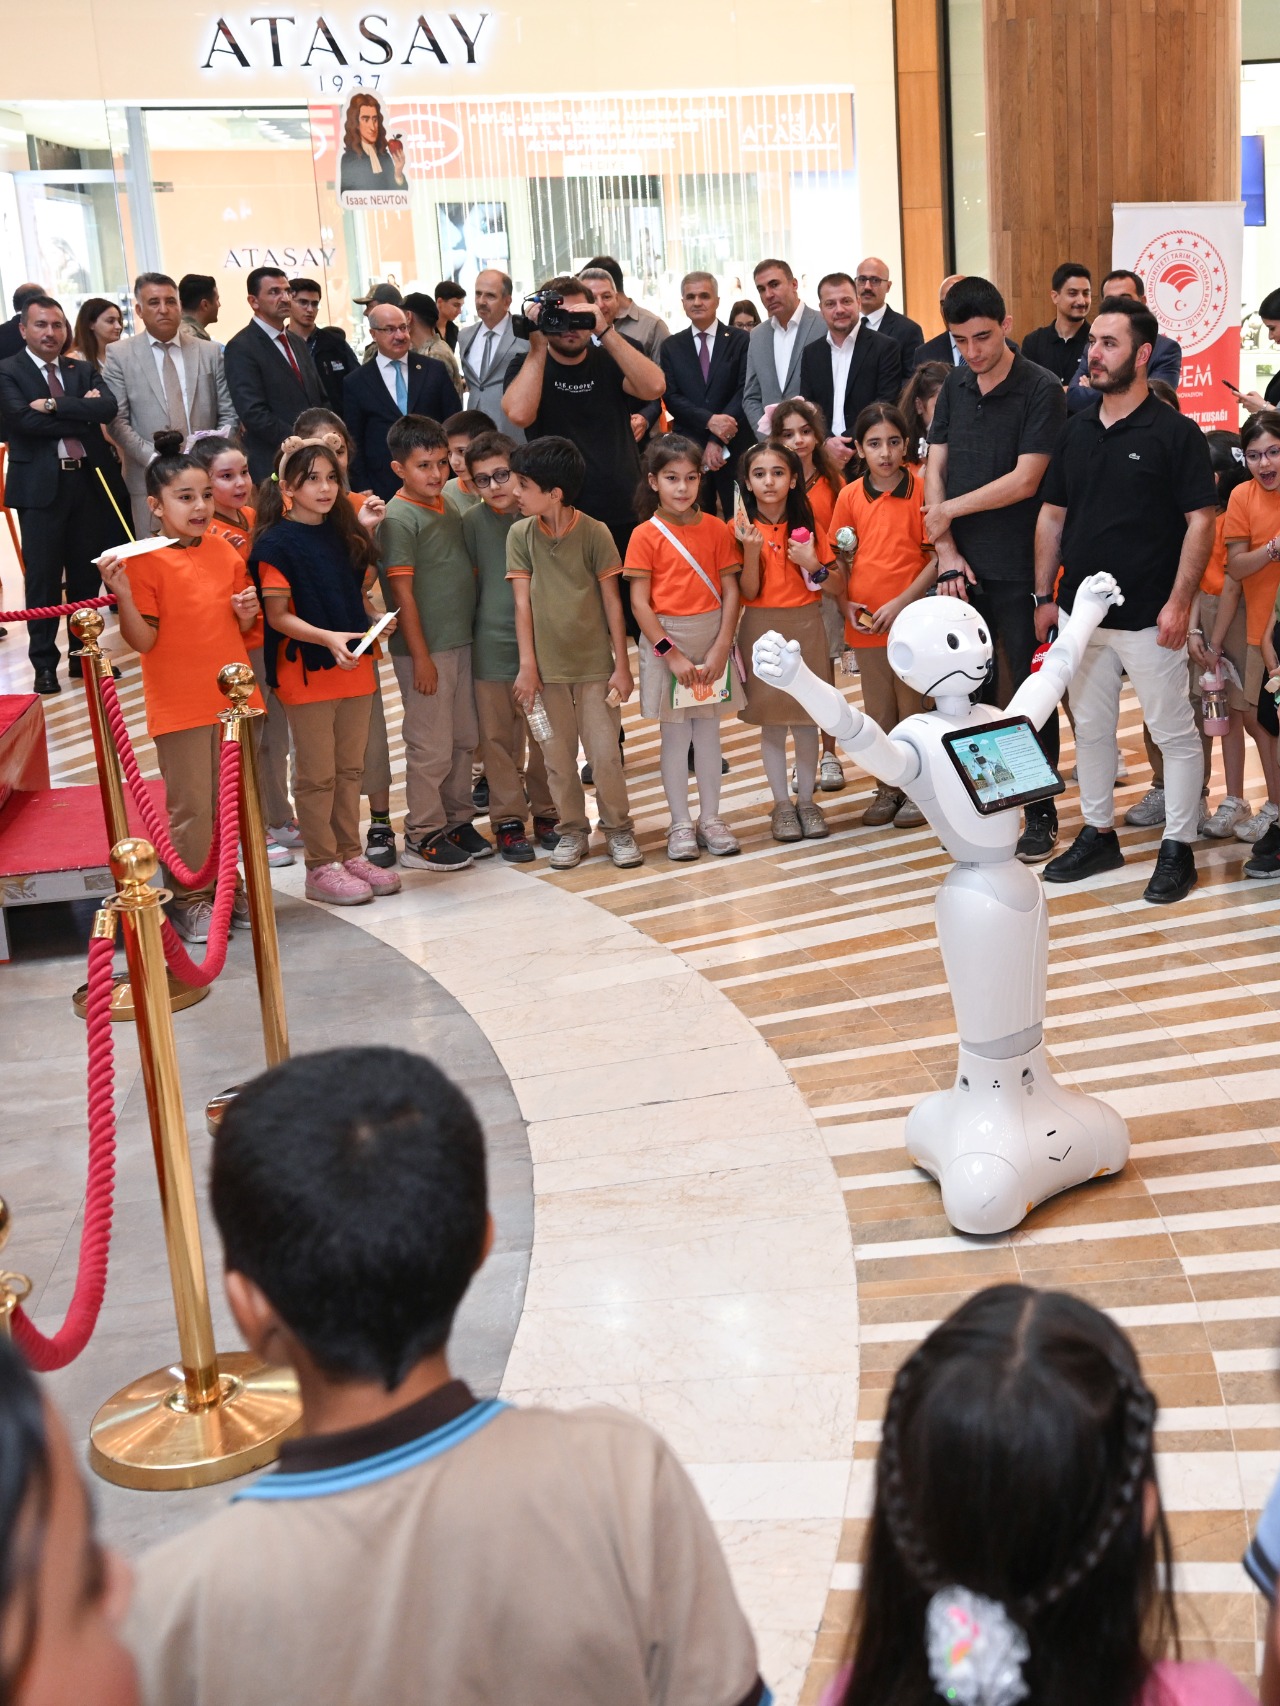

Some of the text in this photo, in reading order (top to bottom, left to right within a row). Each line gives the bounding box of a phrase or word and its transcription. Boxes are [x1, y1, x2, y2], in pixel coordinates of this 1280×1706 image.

[201, 13, 489, 68] ATASAY
[320, 74, 381, 92] 1937
[742, 123, 836, 144] ATASAY
[346, 195, 408, 205] Isaac NEWTON
[224, 247, 336, 268] ATASAY
